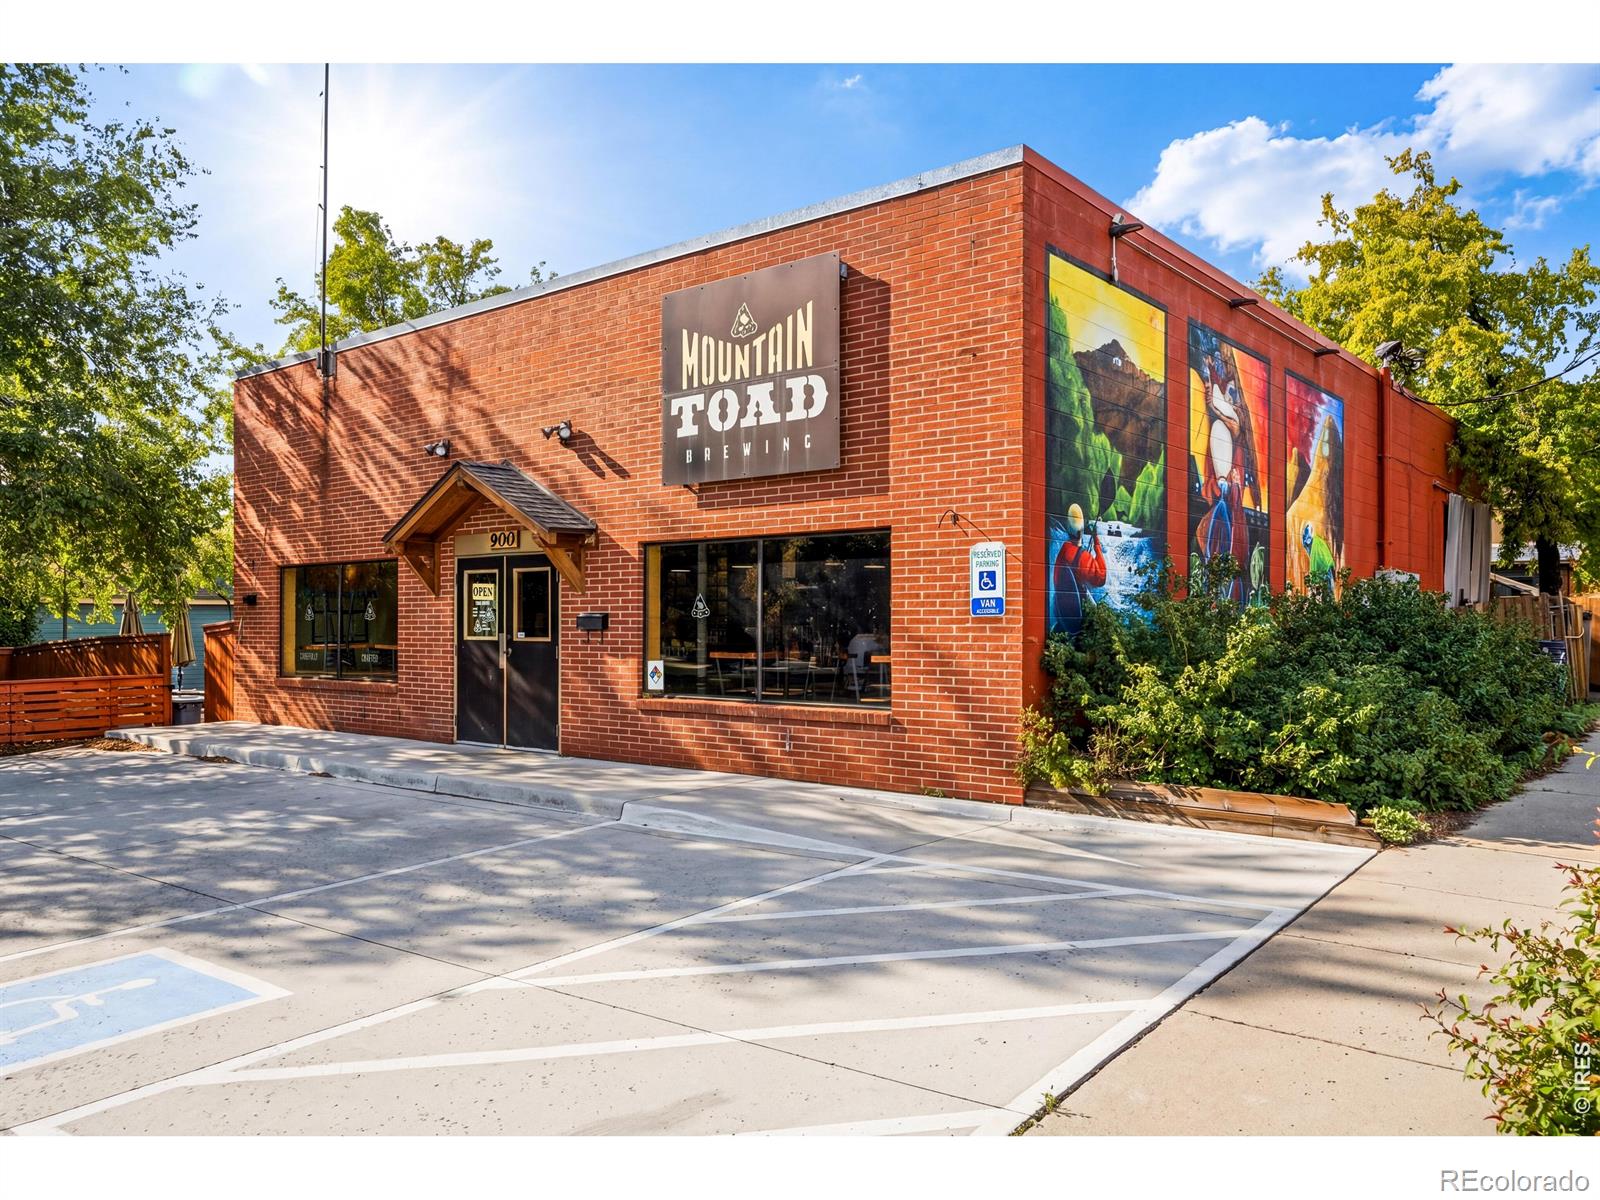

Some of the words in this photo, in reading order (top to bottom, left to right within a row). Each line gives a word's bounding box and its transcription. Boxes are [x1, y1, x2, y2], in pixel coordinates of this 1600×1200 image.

[682, 300, 813, 391] MOUNTAIN
[671, 374, 829, 438] TOAD
[686, 434, 811, 464] BREWING
[490, 531, 516, 548] 900
[973, 549, 1001, 559] RESERVED
[975, 560, 999, 568] PARKING
[473, 586, 493, 597] OPEN
[980, 599, 996, 608] VAN
